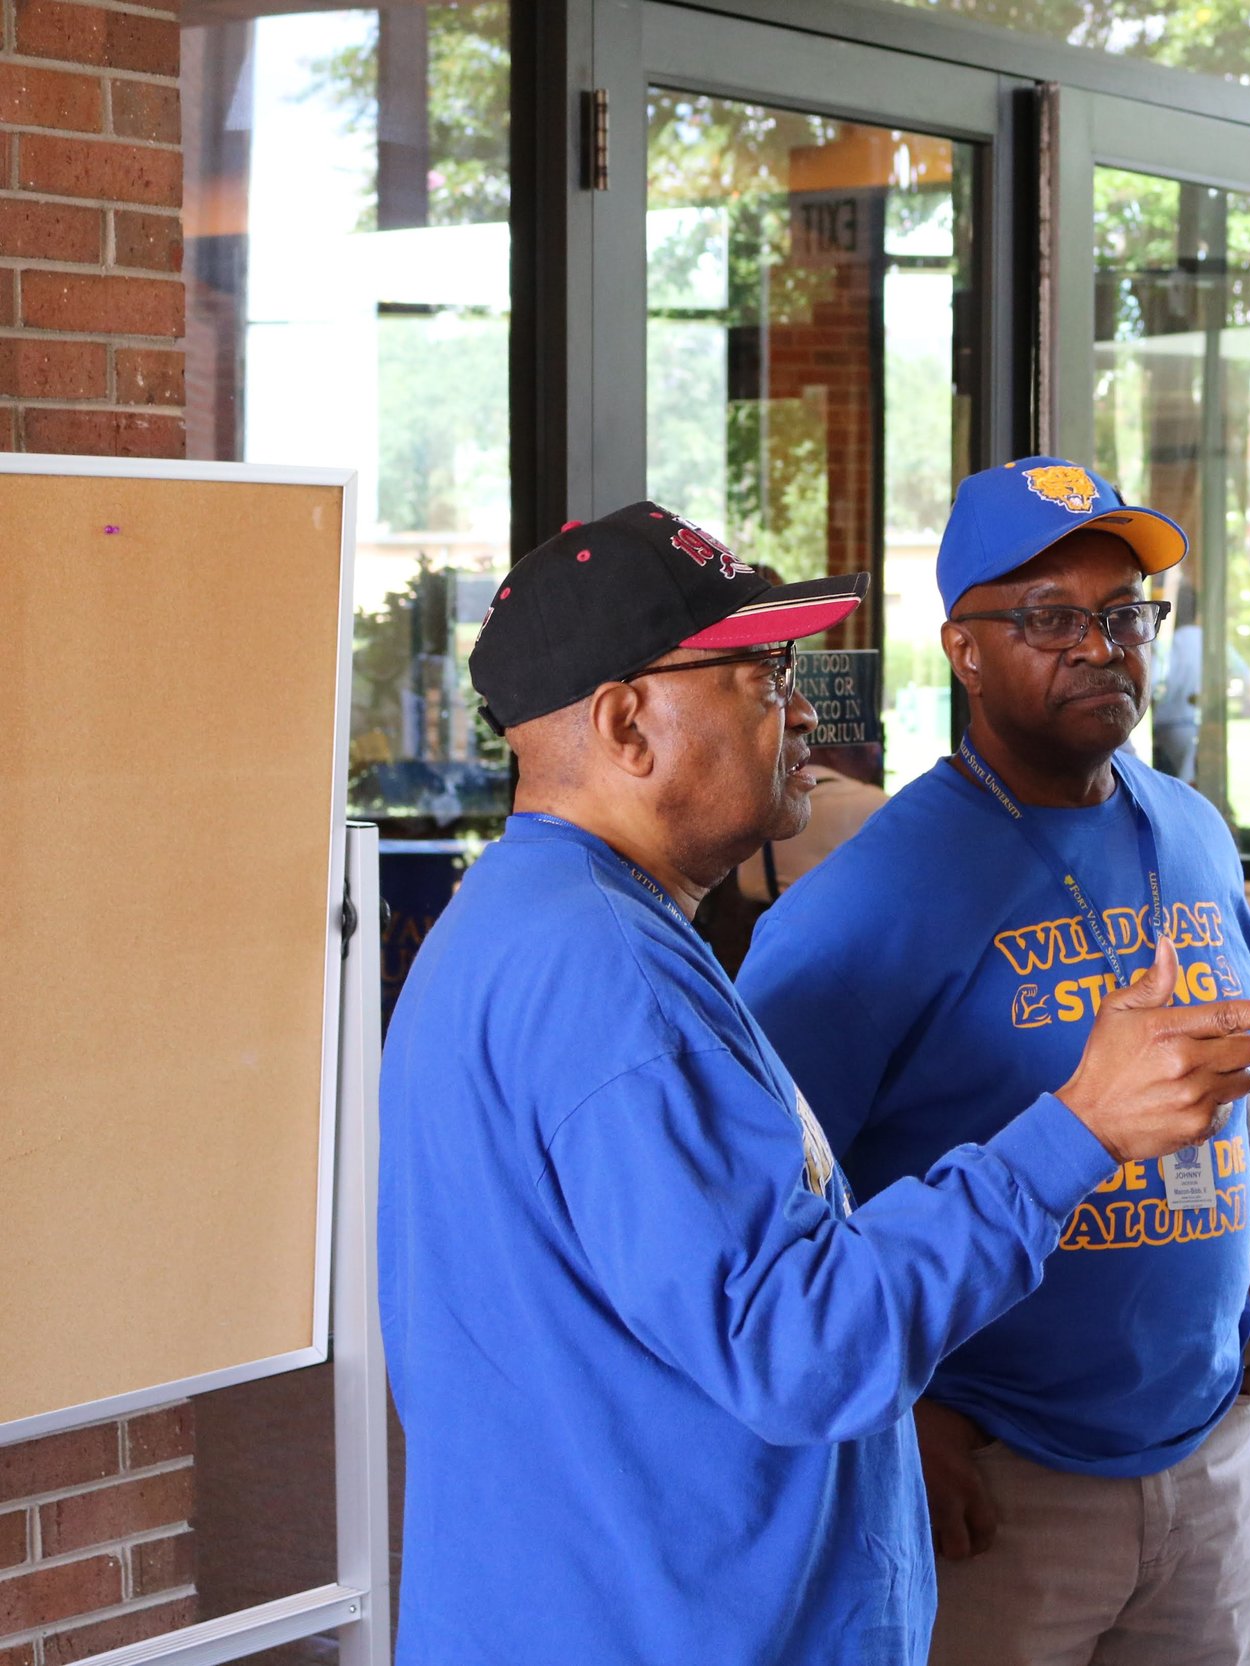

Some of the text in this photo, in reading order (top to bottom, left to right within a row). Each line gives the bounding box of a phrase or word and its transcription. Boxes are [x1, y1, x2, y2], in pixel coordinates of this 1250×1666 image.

[813, 654, 849, 674] FOOD
[834, 676, 854, 696] OR
[846, 700, 860, 719] IN
[1070, 884, 1089, 910] FORT
[1087, 910, 1108, 946] VALLEY
[1149, 870, 1161, 927] UNIVERSITY
[1214, 1136, 1246, 1178] DIE
[1059, 1183, 1248, 1250] ALUMNI
